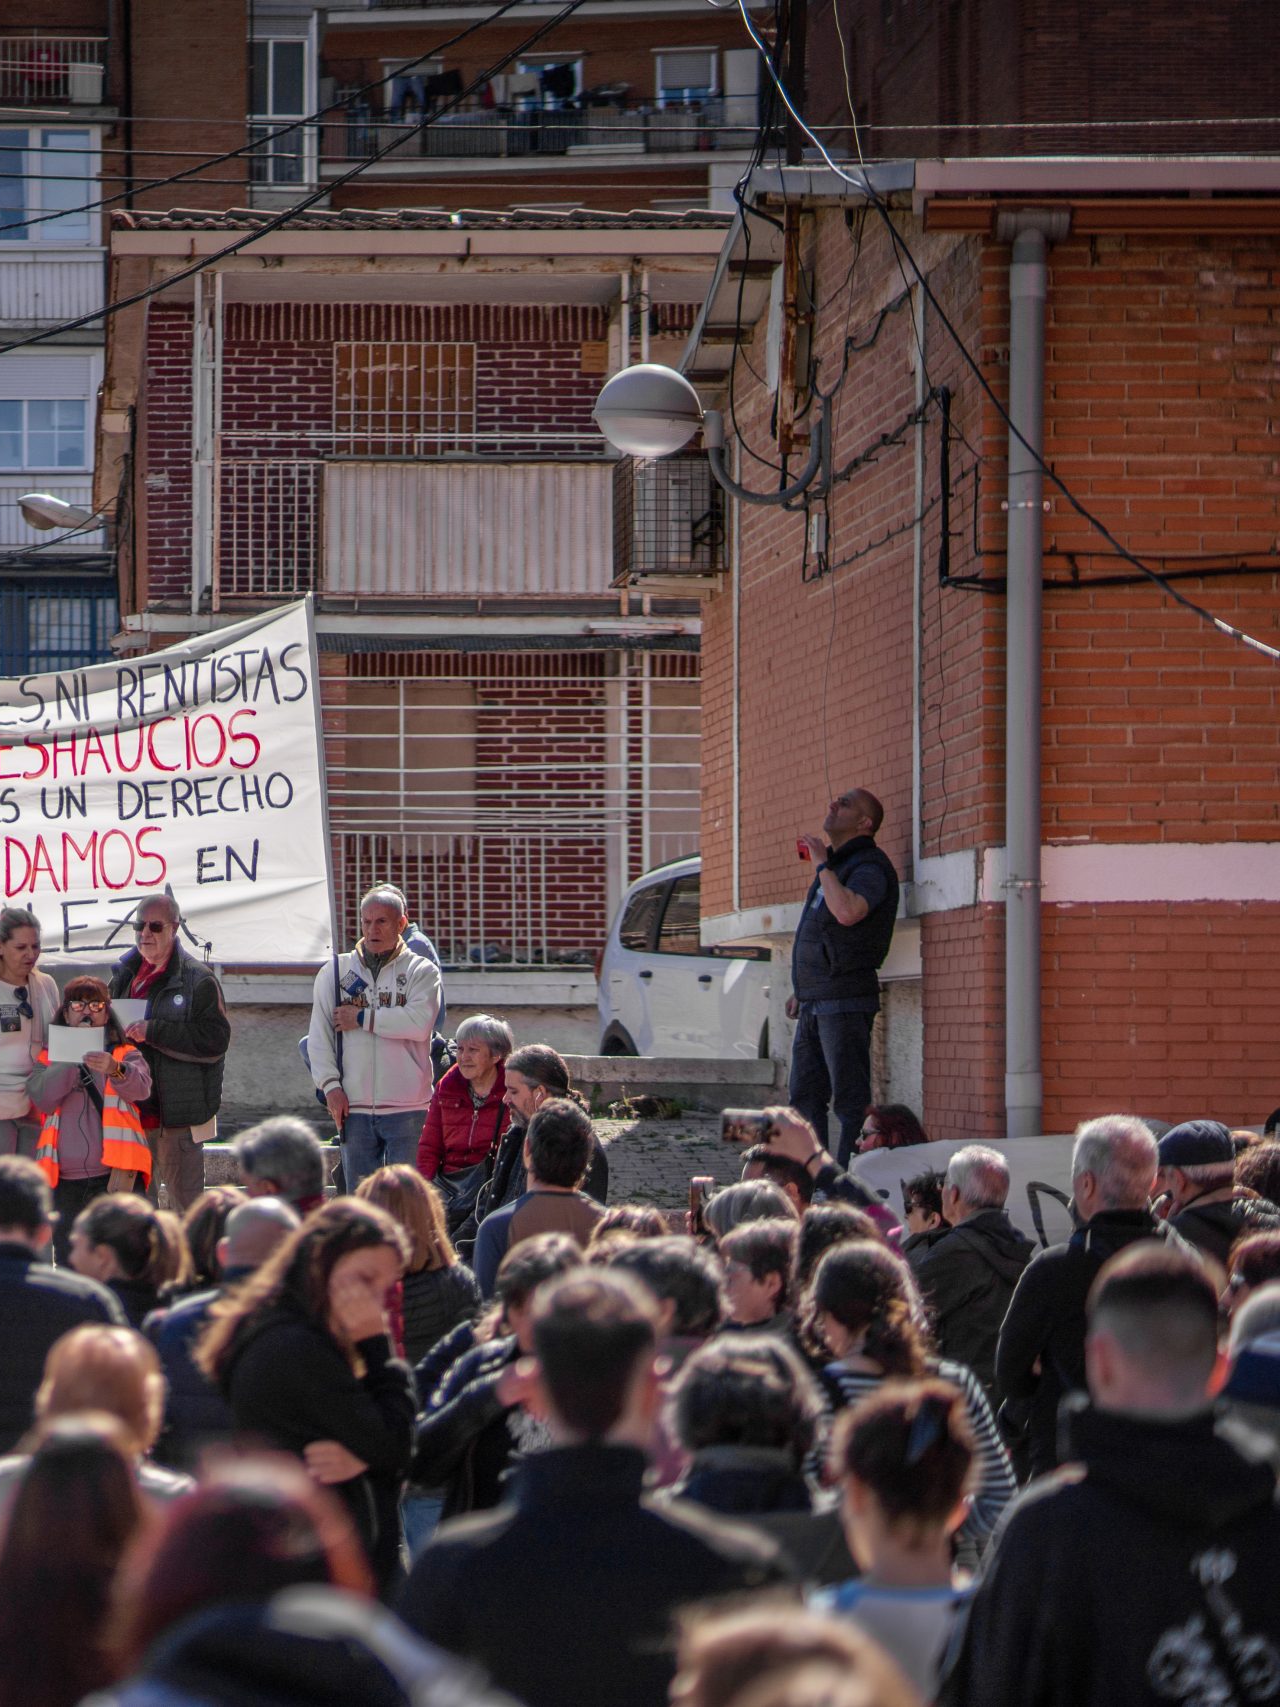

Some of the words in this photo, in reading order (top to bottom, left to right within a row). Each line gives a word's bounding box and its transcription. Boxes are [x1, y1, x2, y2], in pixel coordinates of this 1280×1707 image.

[40, 782, 88, 820] UN
[117, 772, 294, 821] DERECHO
[196, 838, 260, 885] EN
